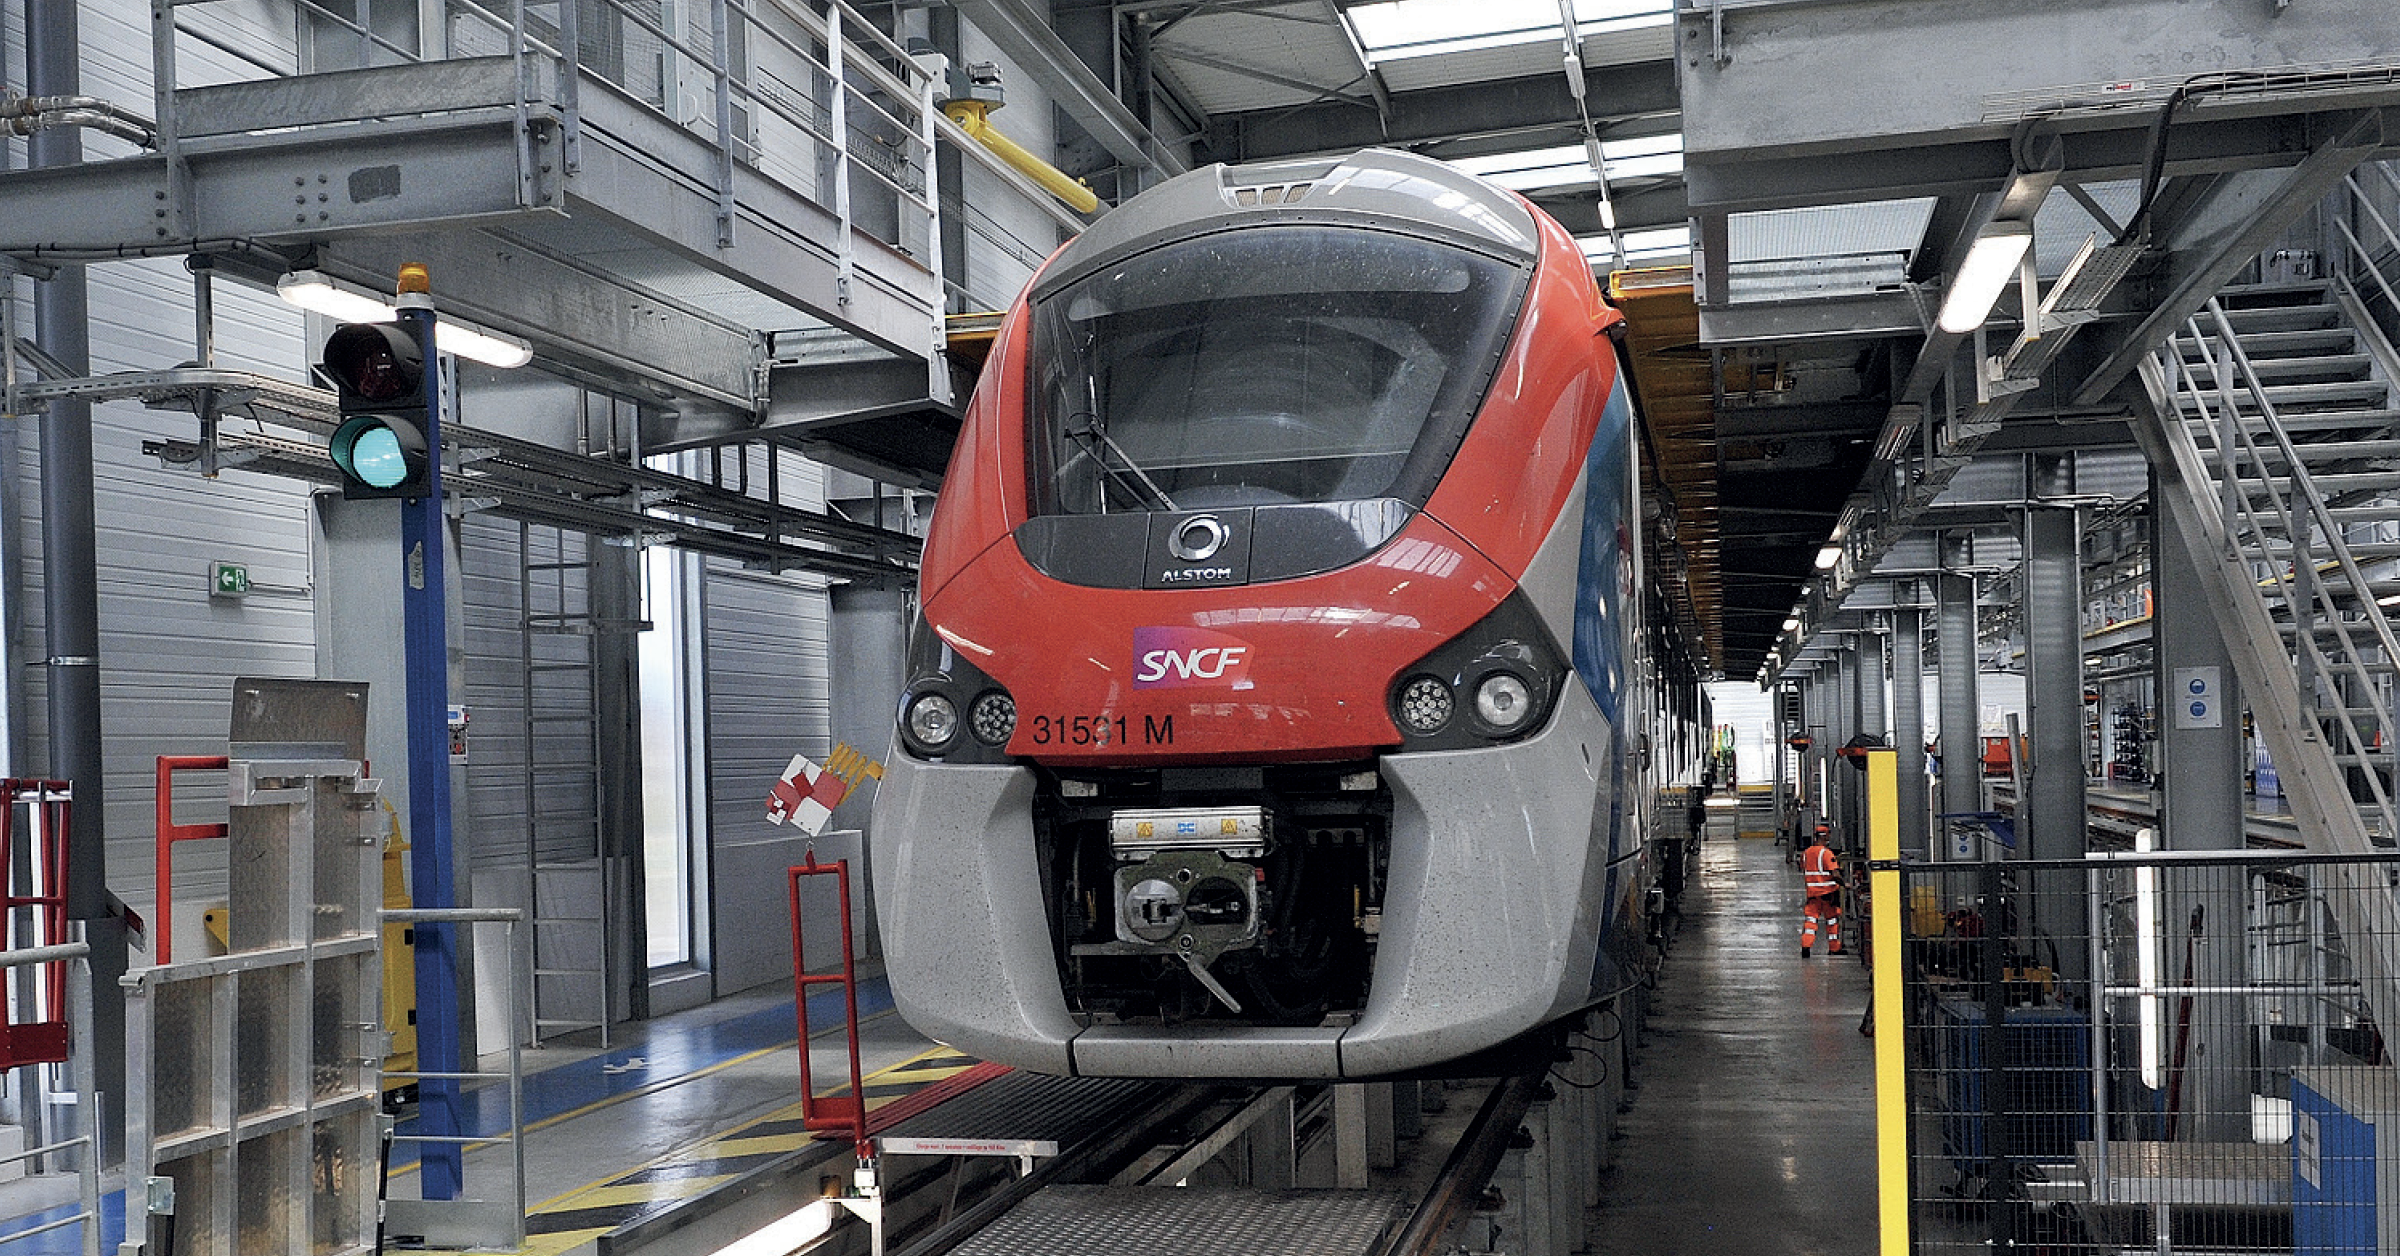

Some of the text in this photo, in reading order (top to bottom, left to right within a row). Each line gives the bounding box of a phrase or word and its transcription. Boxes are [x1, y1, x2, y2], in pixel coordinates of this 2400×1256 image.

[1161, 567, 1231, 582] ALSTOM
[1137, 646, 1246, 682] SNCF
[1033, 714, 1174, 746] 31531 M
